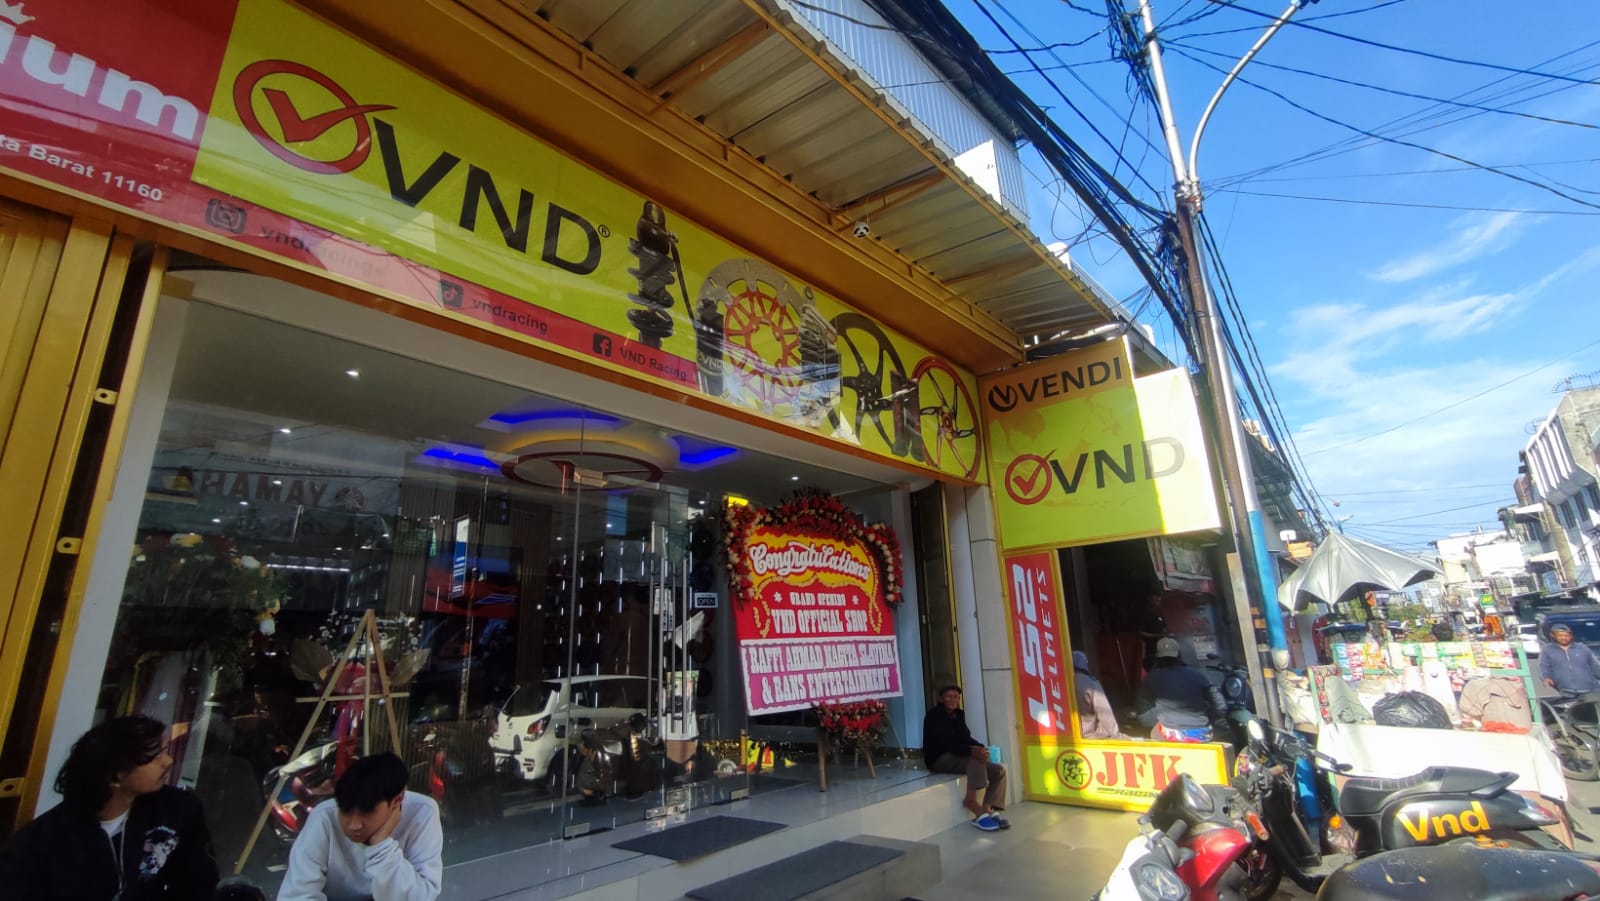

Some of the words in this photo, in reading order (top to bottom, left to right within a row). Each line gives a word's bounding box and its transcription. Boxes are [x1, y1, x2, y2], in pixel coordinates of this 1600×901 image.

[28, 143, 96, 178] Barat
[102, 171, 163, 201] 11160
[373, 116, 602, 277] VND
[472, 298, 549, 336] vndracing
[619, 346, 647, 367] VND
[649, 358, 687, 382] Racing
[1017, 356, 1123, 403] VENDI
[1049, 435, 1185, 495] VND
[749, 540, 871, 580] Congratulations
[789, 591, 816, 606] GRAND
[817, 593, 847, 606] OPENING
[771, 609, 797, 634] VND
[797, 609, 845, 633] OFFICIAL
[844, 609, 868, 632] SHOP
[749, 646, 785, 675] RAFFI
[1011, 562, 1051, 729] LS2
[1035, 567, 1066, 732] HELMETS
[761, 676, 774, 705] &
[773, 674, 807, 703] RANS
[806, 667, 891, 699] ENTERTAINMENT
[1095, 751, 1182, 791] JFK
[1395, 800, 1491, 842] Vnd
